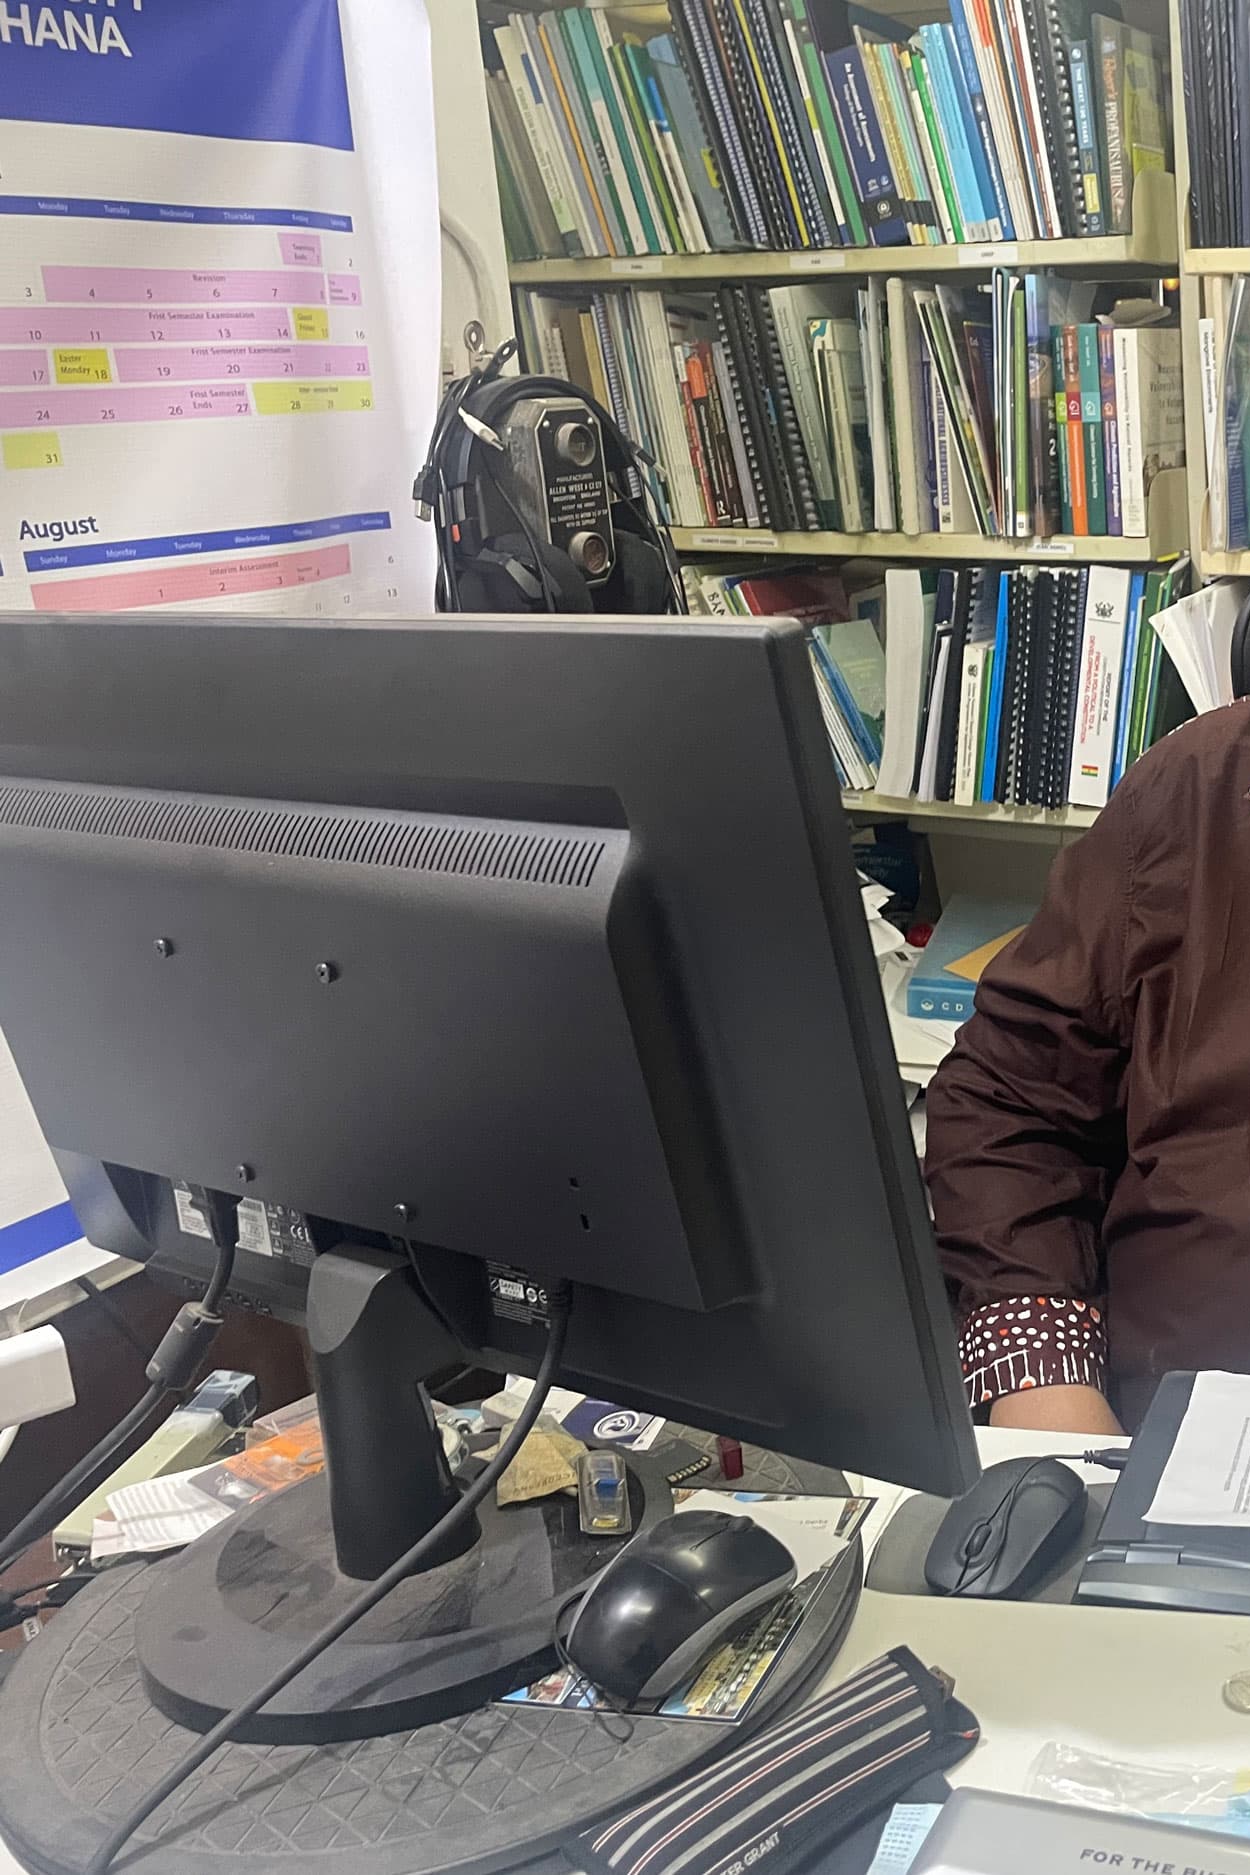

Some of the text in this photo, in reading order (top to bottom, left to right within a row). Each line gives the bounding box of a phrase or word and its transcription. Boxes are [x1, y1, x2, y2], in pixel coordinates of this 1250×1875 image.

[25, 287, 32, 297] 3
[89, 288, 96, 298] 4
[147, 288, 153, 299] 5
[213, 287, 221, 298] 6
[272, 287, 279, 298] 7
[29, 330, 42, 341] 10
[90, 330, 101, 341] 11
[149, 330, 164, 341] 12
[219, 328, 231, 339] 13
[278, 328, 289, 338] 14
[95, 368, 108, 380] 18
[157, 366, 171, 377] 19
[227, 364, 240, 375] 20
[284, 363, 294, 373] 21
[37, 410, 50, 421] 24
[101, 408, 115, 420] 25
[168, 405, 184, 416] 26
[237, 403, 249, 414] 27
[45, 453, 59, 464] 31
[20, 515, 100, 542] August
[106, 547, 136, 559] Monday
[744, 1831, 780, 1866] GRANT
[1079, 1848, 1176, 1875] FOR THE
